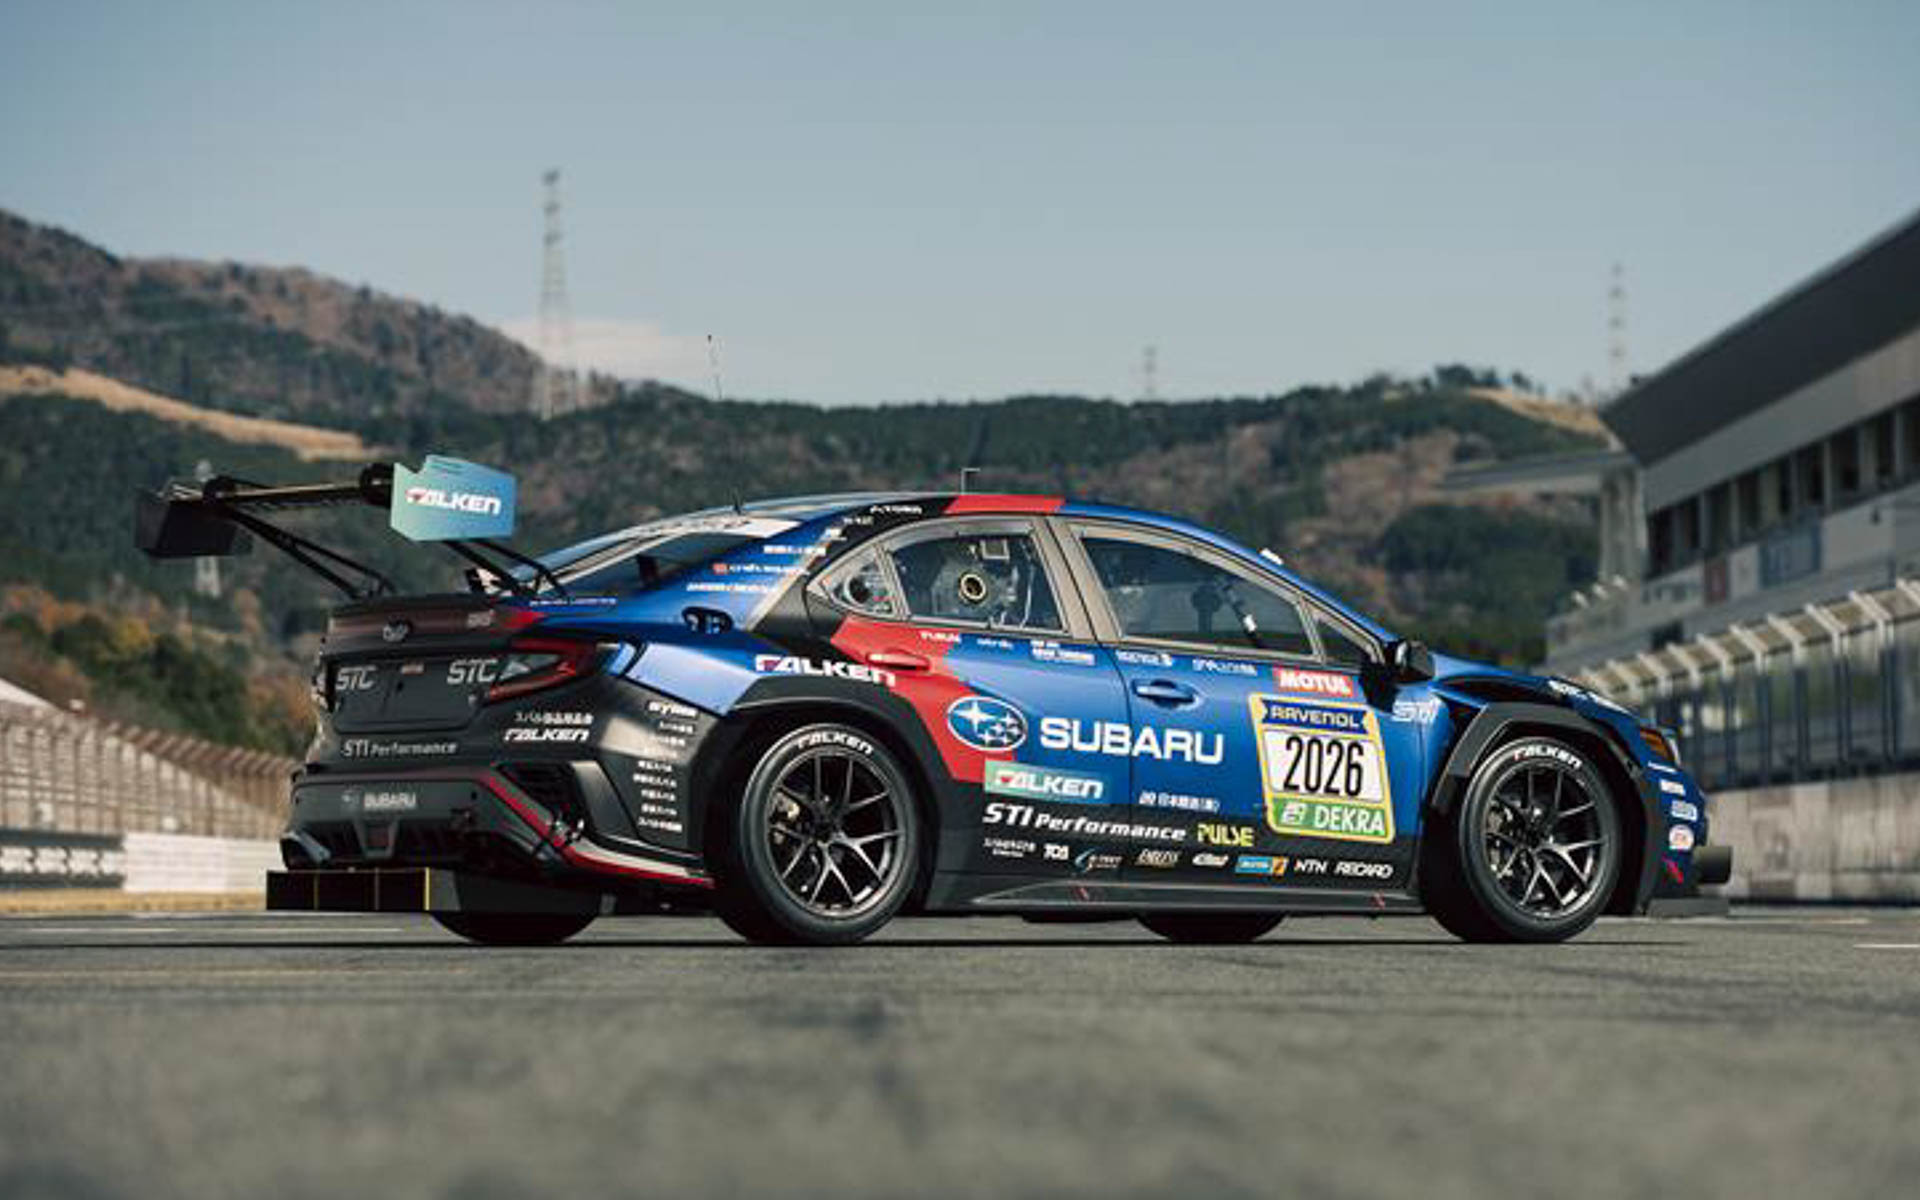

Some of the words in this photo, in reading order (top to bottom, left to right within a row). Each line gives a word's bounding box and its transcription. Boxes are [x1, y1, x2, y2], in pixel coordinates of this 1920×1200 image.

[405, 487, 502, 516] FALKEN
[336, 665, 377, 690] STC
[447, 658, 499, 684] STC
[755, 654, 896, 686] FALKEN
[1280, 671, 1351, 694] MOTUL
[1271, 704, 1360, 728] RAVENOL
[344, 739, 368, 757] STI
[371, 741, 457, 756] Performance
[504, 728, 590, 743] FALKEN
[798, 731, 874, 755] FALKEN
[1039, 716, 1224, 765] SUBARU
[1283, 735, 1365, 797] 2026
[994, 769, 1104, 799] FALKEN
[364, 792, 417, 809] SUBARU
[982, 802, 1034, 826] STI
[1035, 812, 1187, 842] Performance
[1314, 805, 1386, 835] DEKRA
[1196, 823, 1255, 847] PULSE
[1294, 858, 1328, 874] NTN
[1335, 862, 1394, 879] RECARO
